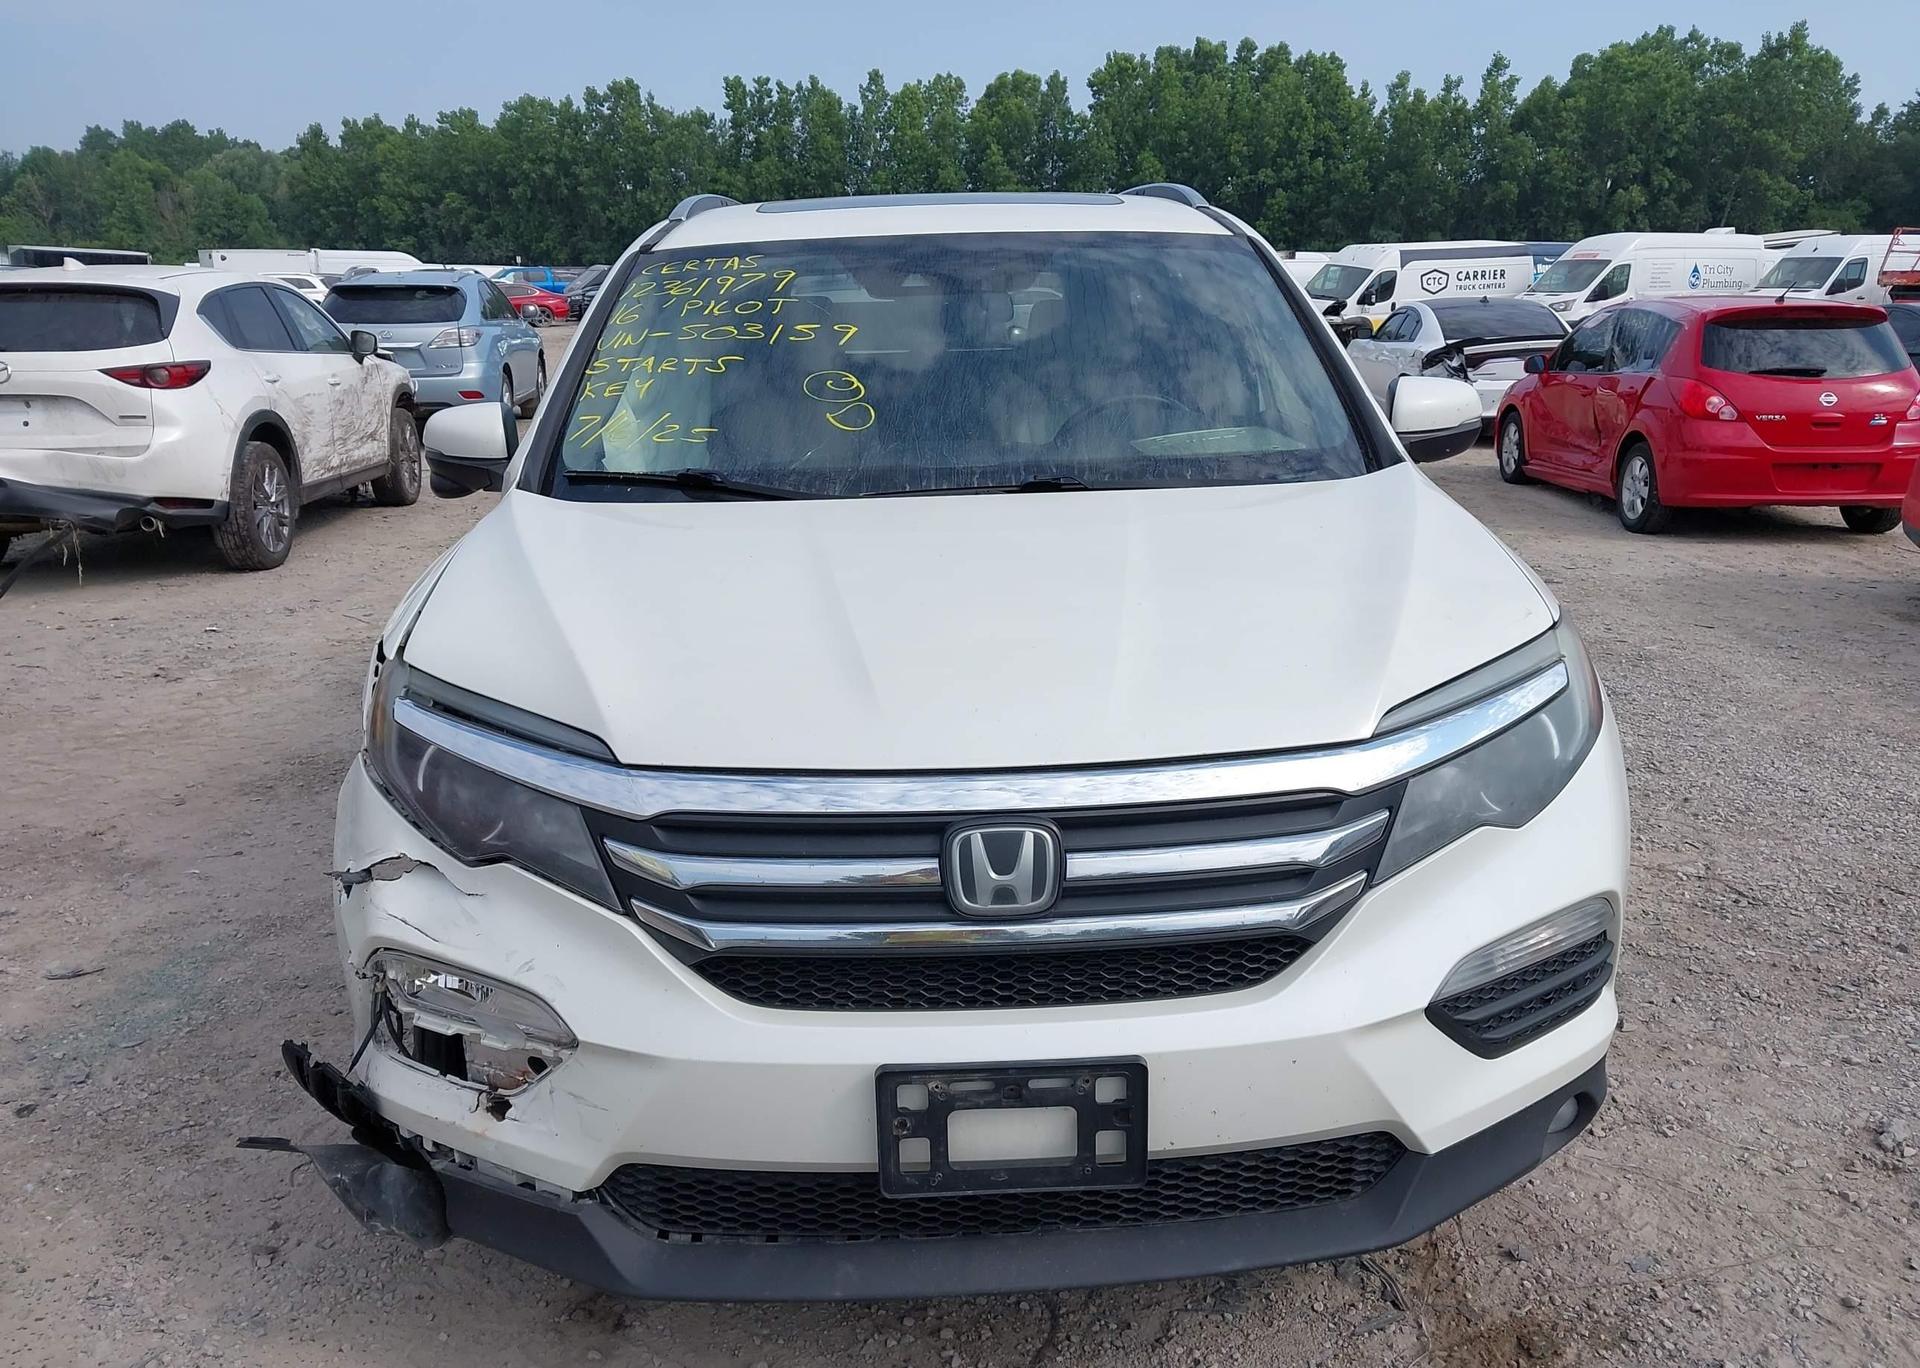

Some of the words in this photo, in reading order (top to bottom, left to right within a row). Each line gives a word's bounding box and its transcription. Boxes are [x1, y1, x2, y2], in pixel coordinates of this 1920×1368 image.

[641, 254, 765, 276] CERTAS
[1703, 264, 1715, 275] Tri
[1716, 264, 1734, 276] City
[1426, 276, 1443, 286] CTC
[1456, 269, 1506, 281] CARRIER
[1478, 282, 1506, 290] CENTERS
[1701, 278, 1743, 290] Plumbing
[585, 356, 745, 375] STARTS
[580, 379, 655, 401] KEY
